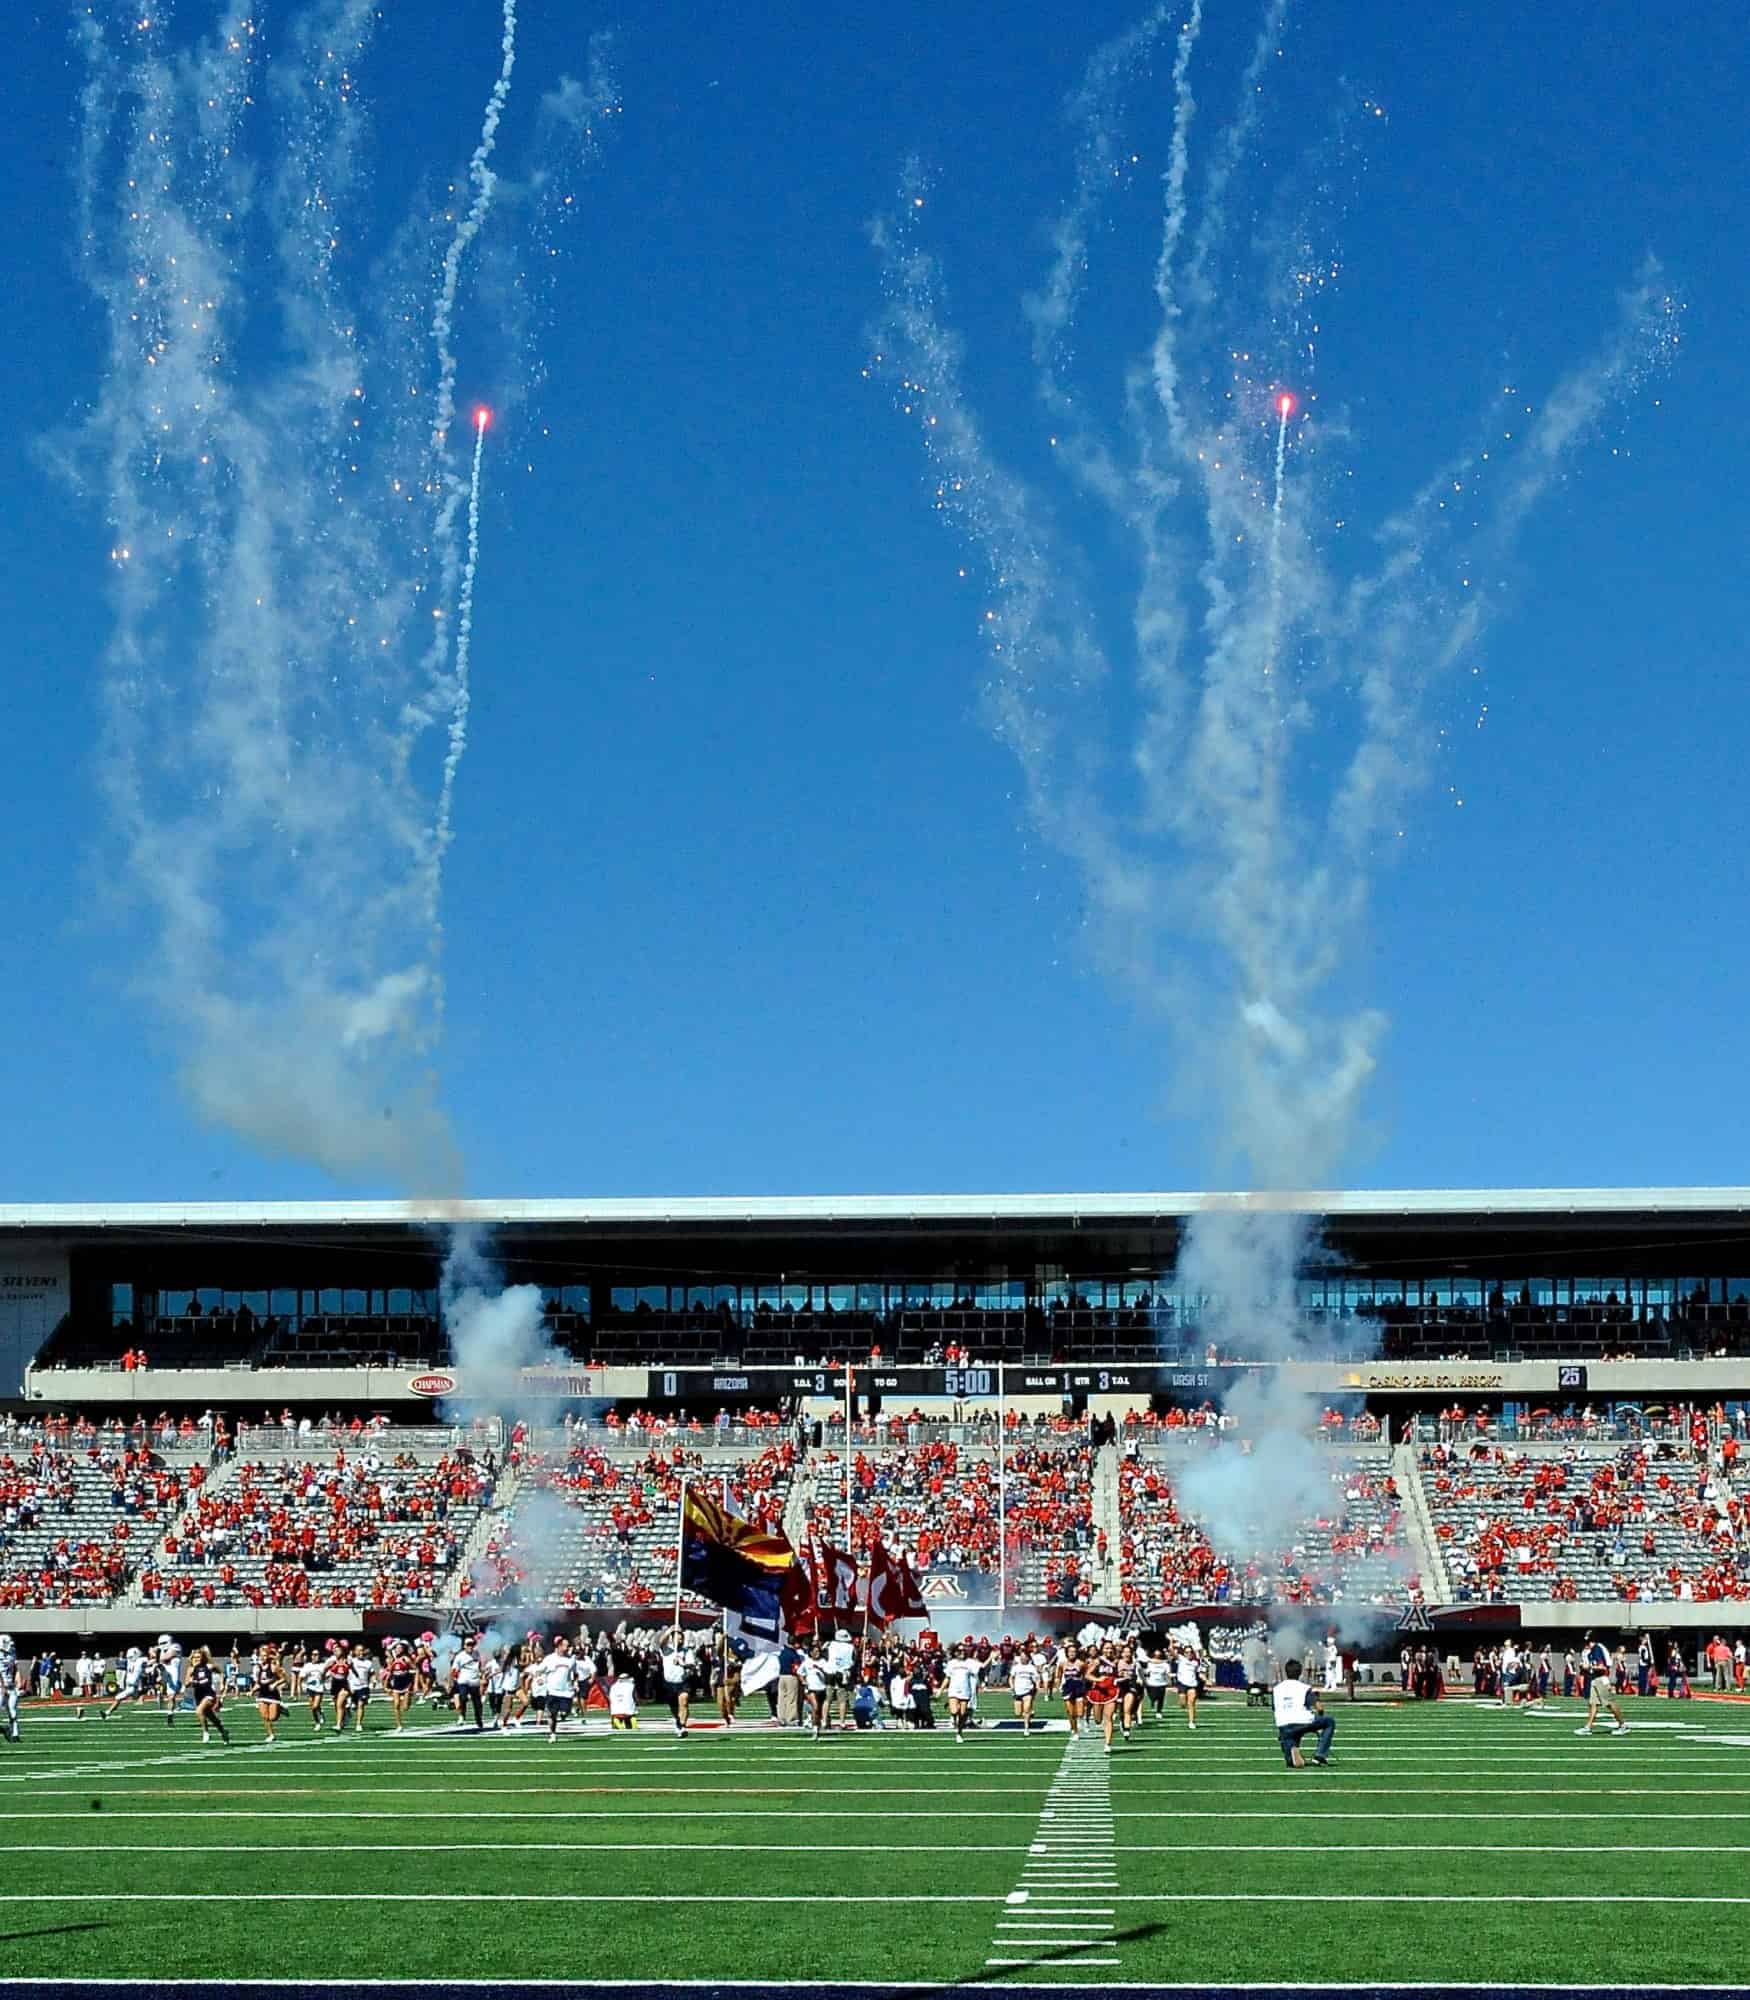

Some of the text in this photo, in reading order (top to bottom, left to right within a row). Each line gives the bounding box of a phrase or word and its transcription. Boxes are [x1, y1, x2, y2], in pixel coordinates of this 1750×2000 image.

[664, 1373, 677, 1396] 0
[713, 1377, 748, 1390] ARIZONA
[815, 1374, 825, 1392] 3
[874, 1378, 898, 1387] TO GO
[945, 1371, 991, 1393] 5:00
[1025, 1376, 1057, 1386] BALL ON
[1063, 1372, 1072, 1391] 1
[1099, 1371, 1109, 1391] 3
[1172, 1375, 1209, 1387] WASH ST
[1369, 1375, 1502, 1388] CASINO DEL SOL RESORT
[1560, 1368, 1580, 1386] 25
[413, 1379, 451, 1391] CHAPMAN
